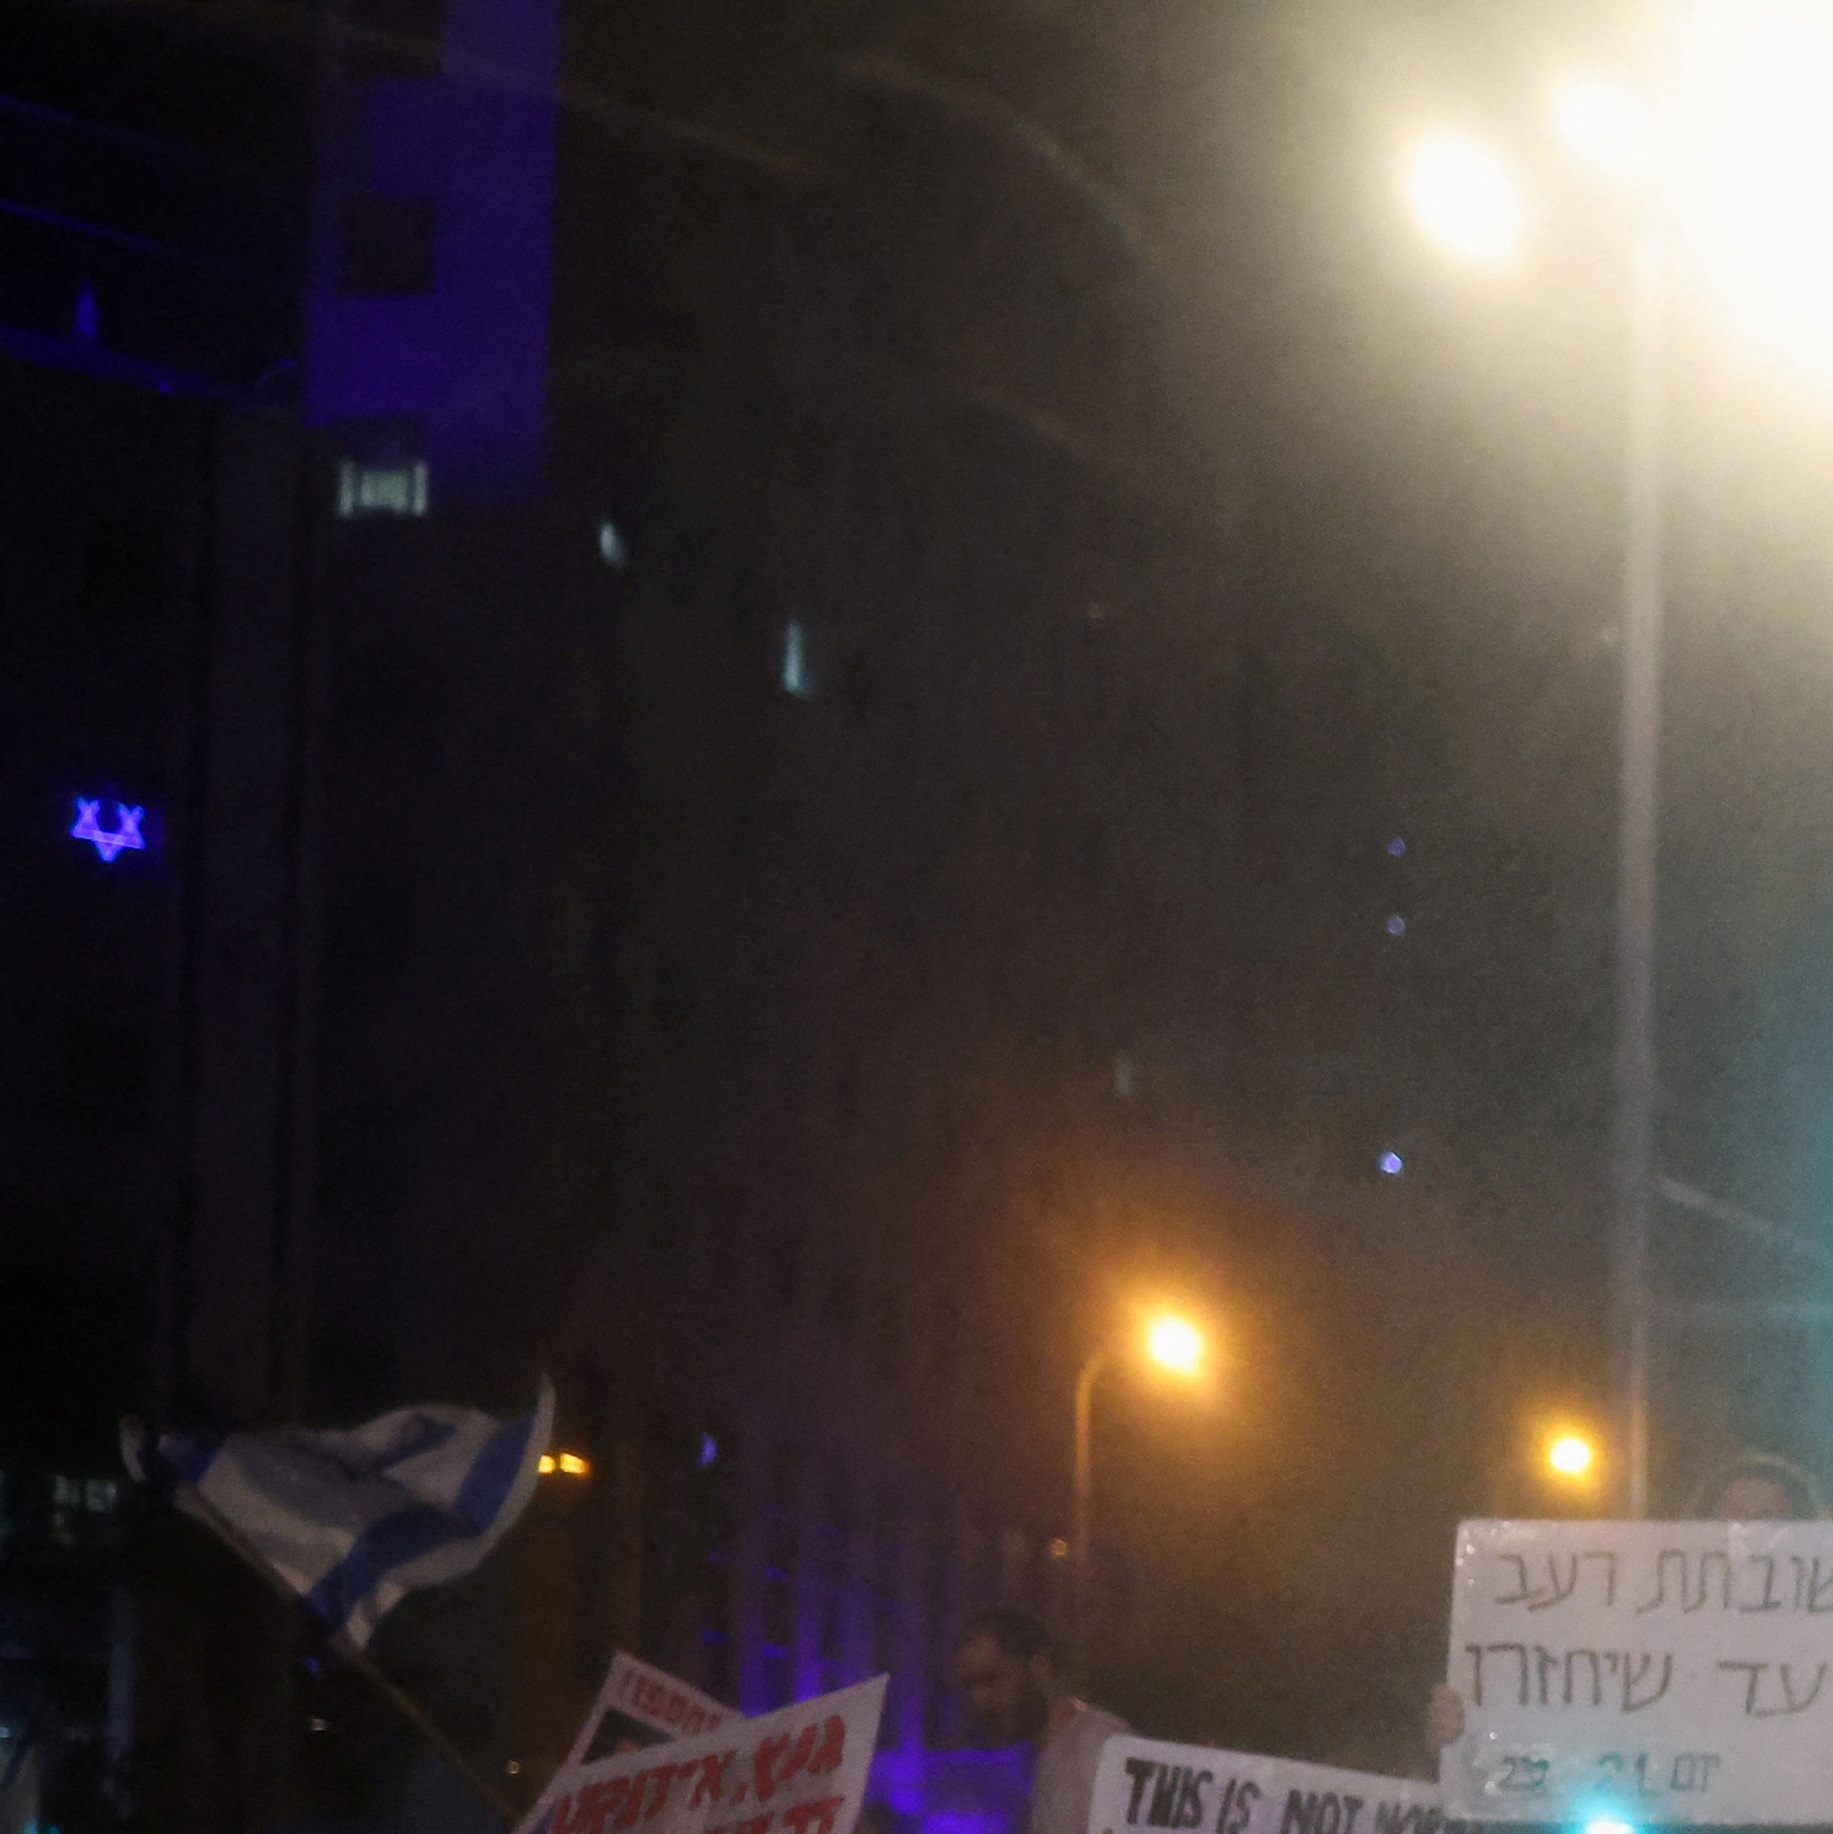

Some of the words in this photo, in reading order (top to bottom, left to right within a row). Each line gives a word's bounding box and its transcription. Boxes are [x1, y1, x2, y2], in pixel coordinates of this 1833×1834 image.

[1494, 1549, 1616, 1612] רעב
[1717, 1660, 1828, 1719] עד
[1124, 1756, 1214, 1830] THIS
